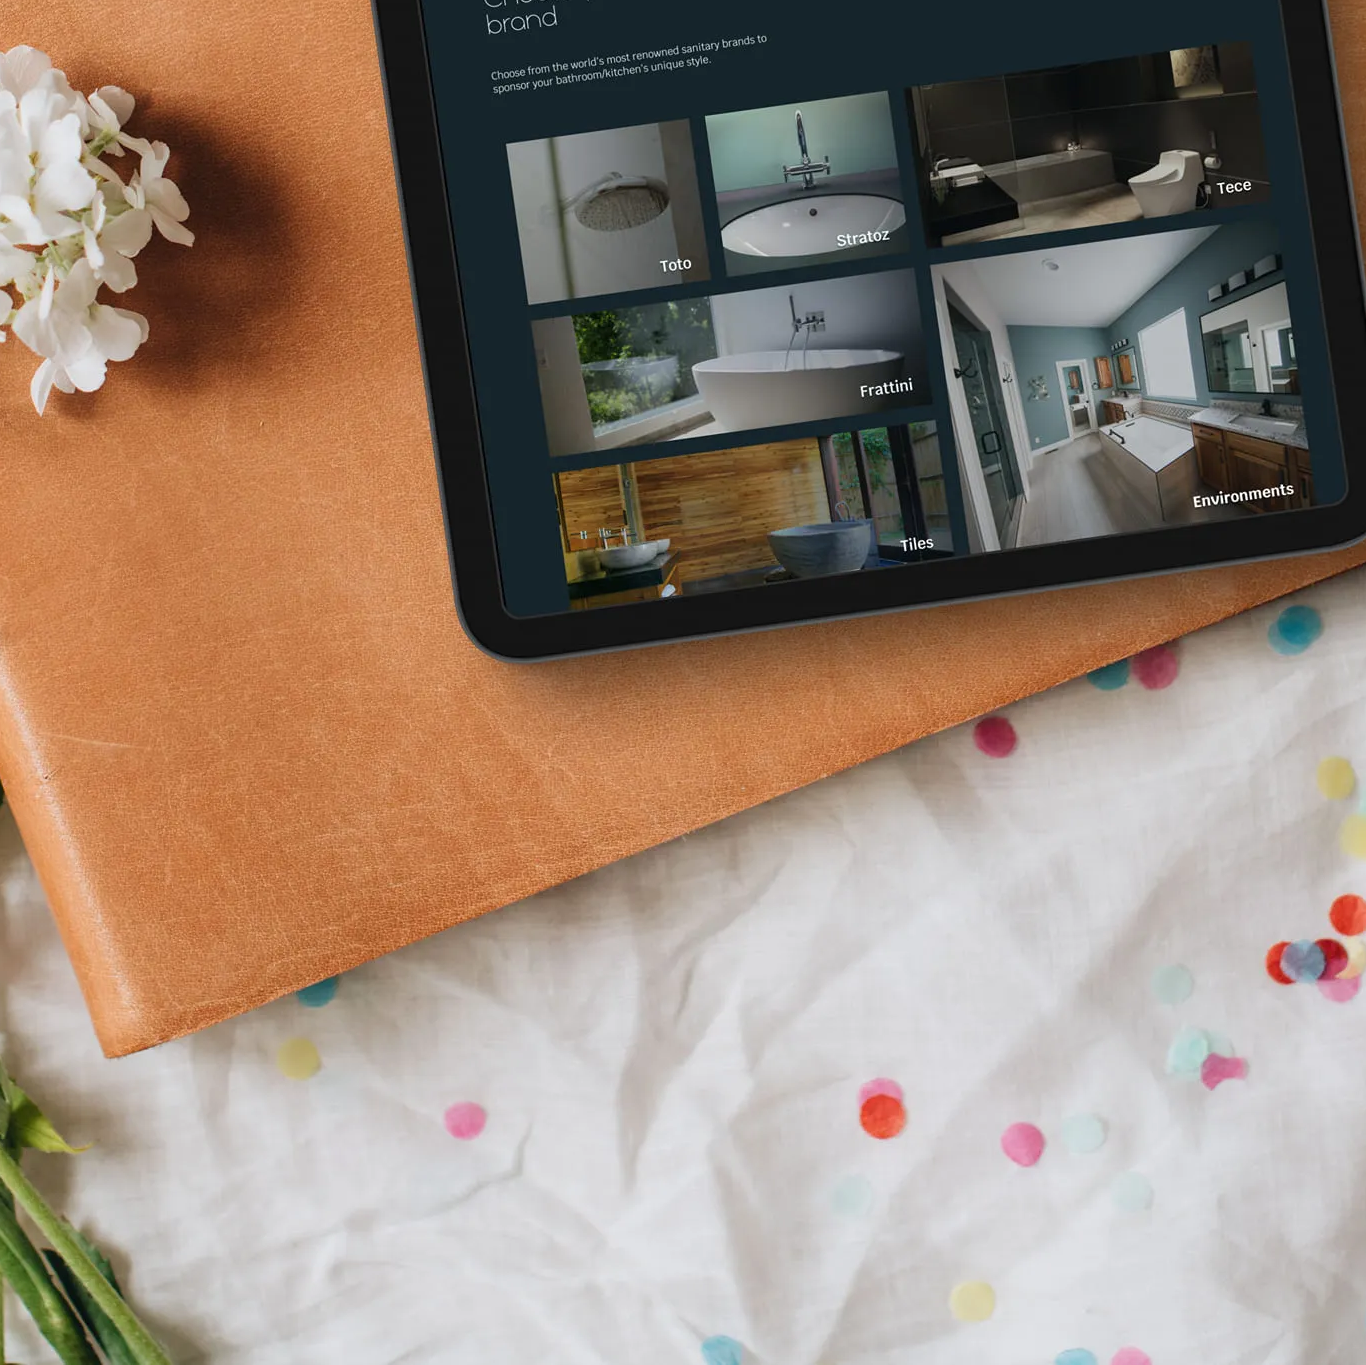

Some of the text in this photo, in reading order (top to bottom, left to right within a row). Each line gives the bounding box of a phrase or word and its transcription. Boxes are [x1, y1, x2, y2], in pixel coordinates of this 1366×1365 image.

[485, 4, 558, 35] brand
[491, 68, 526, 81] Choose
[527, 64, 551, 77] from
[552, 61, 569, 73] the
[606, 53, 631, 65] most
[632, 45, 680, 62] renowned
[681, 39, 720, 55] sanitary
[721, 35, 756, 49] brands
[757, 34, 768, 44] to
[492, 81, 531, 95] sponsor
[532, 78, 553, 91] your
[650, 59, 685, 75] unique
[686, 54, 712, 68] style.
[1216, 180, 1252, 195] Tece
[837, 230, 890, 247] Stratoz
[660, 257, 692, 273] Toto
[860, 377, 913, 398] Frattini
[1192, 482, 1295, 509] Environments
[899, 535, 935, 552] Tiles
